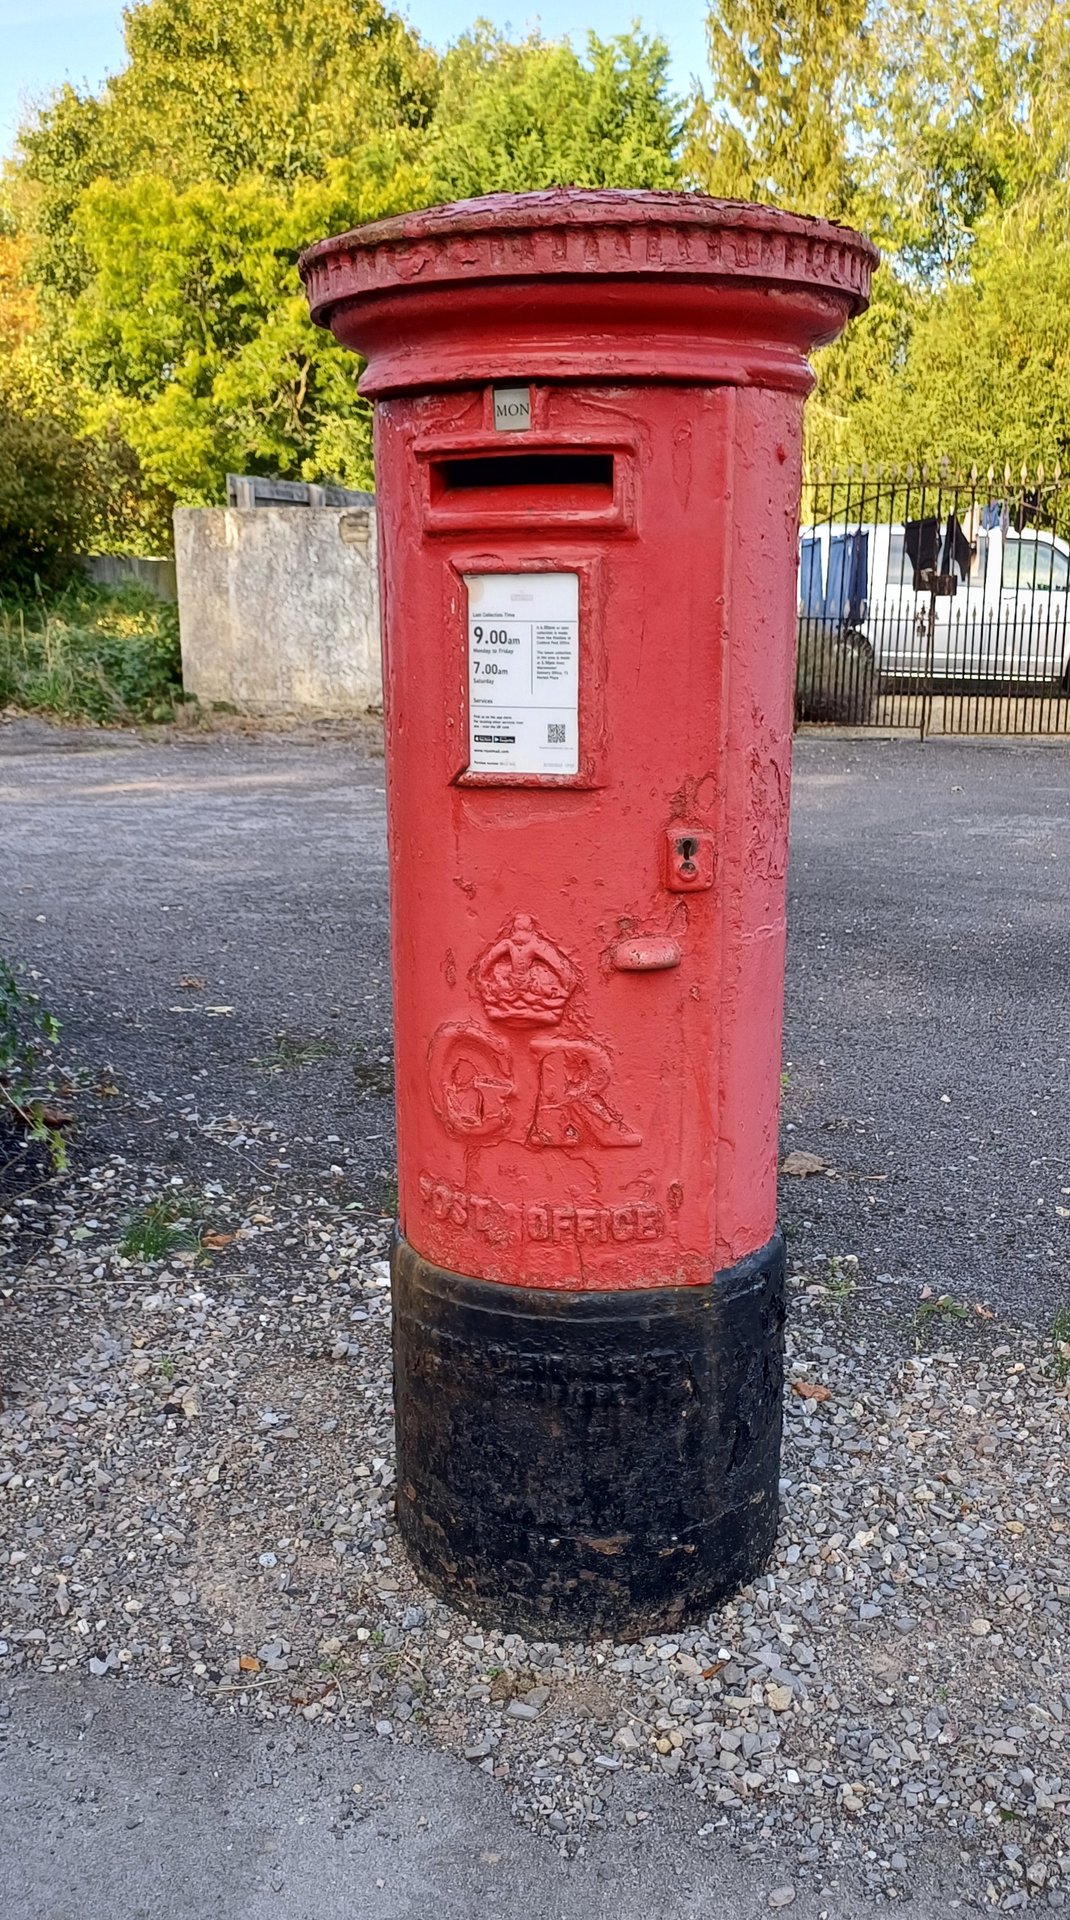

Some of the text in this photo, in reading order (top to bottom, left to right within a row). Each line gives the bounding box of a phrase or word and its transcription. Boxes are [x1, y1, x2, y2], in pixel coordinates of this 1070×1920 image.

[496, 403, 530, 417] MON
[473, 626, 520, 645] 9.00am
[473, 661, 508, 675] 7.00am
[526, 1202, 667, 1243] OFFICE
